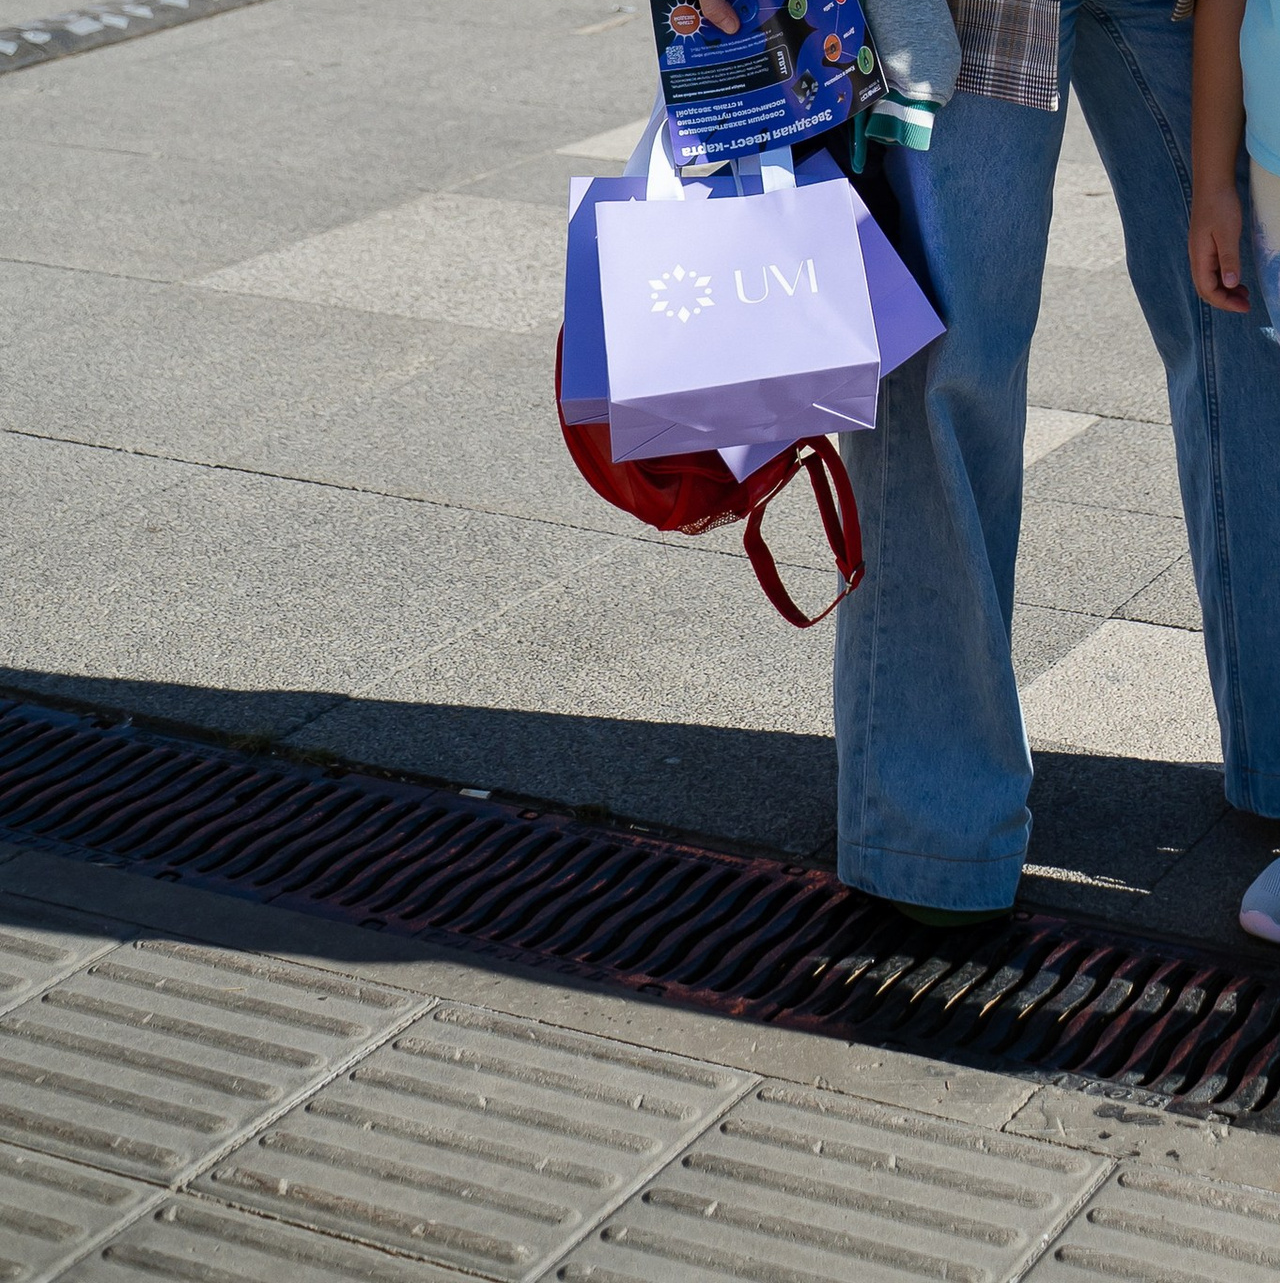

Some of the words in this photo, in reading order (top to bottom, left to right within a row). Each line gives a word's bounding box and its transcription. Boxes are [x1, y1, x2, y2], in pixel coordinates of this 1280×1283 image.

[676, 106, 711, 117] звездой!
[713, 102, 736, 110] стань
[732, 98, 786, 117] космическое
[677, 111, 731, 126] путешествие
[748, 109, 785, 123] Соверши
[773, 109, 832, 139] Звездная
[679, 120, 746, 136] захватывающее
[681, 132, 771, 157] квест-карта
[733, 258, 819, 304] UVI
